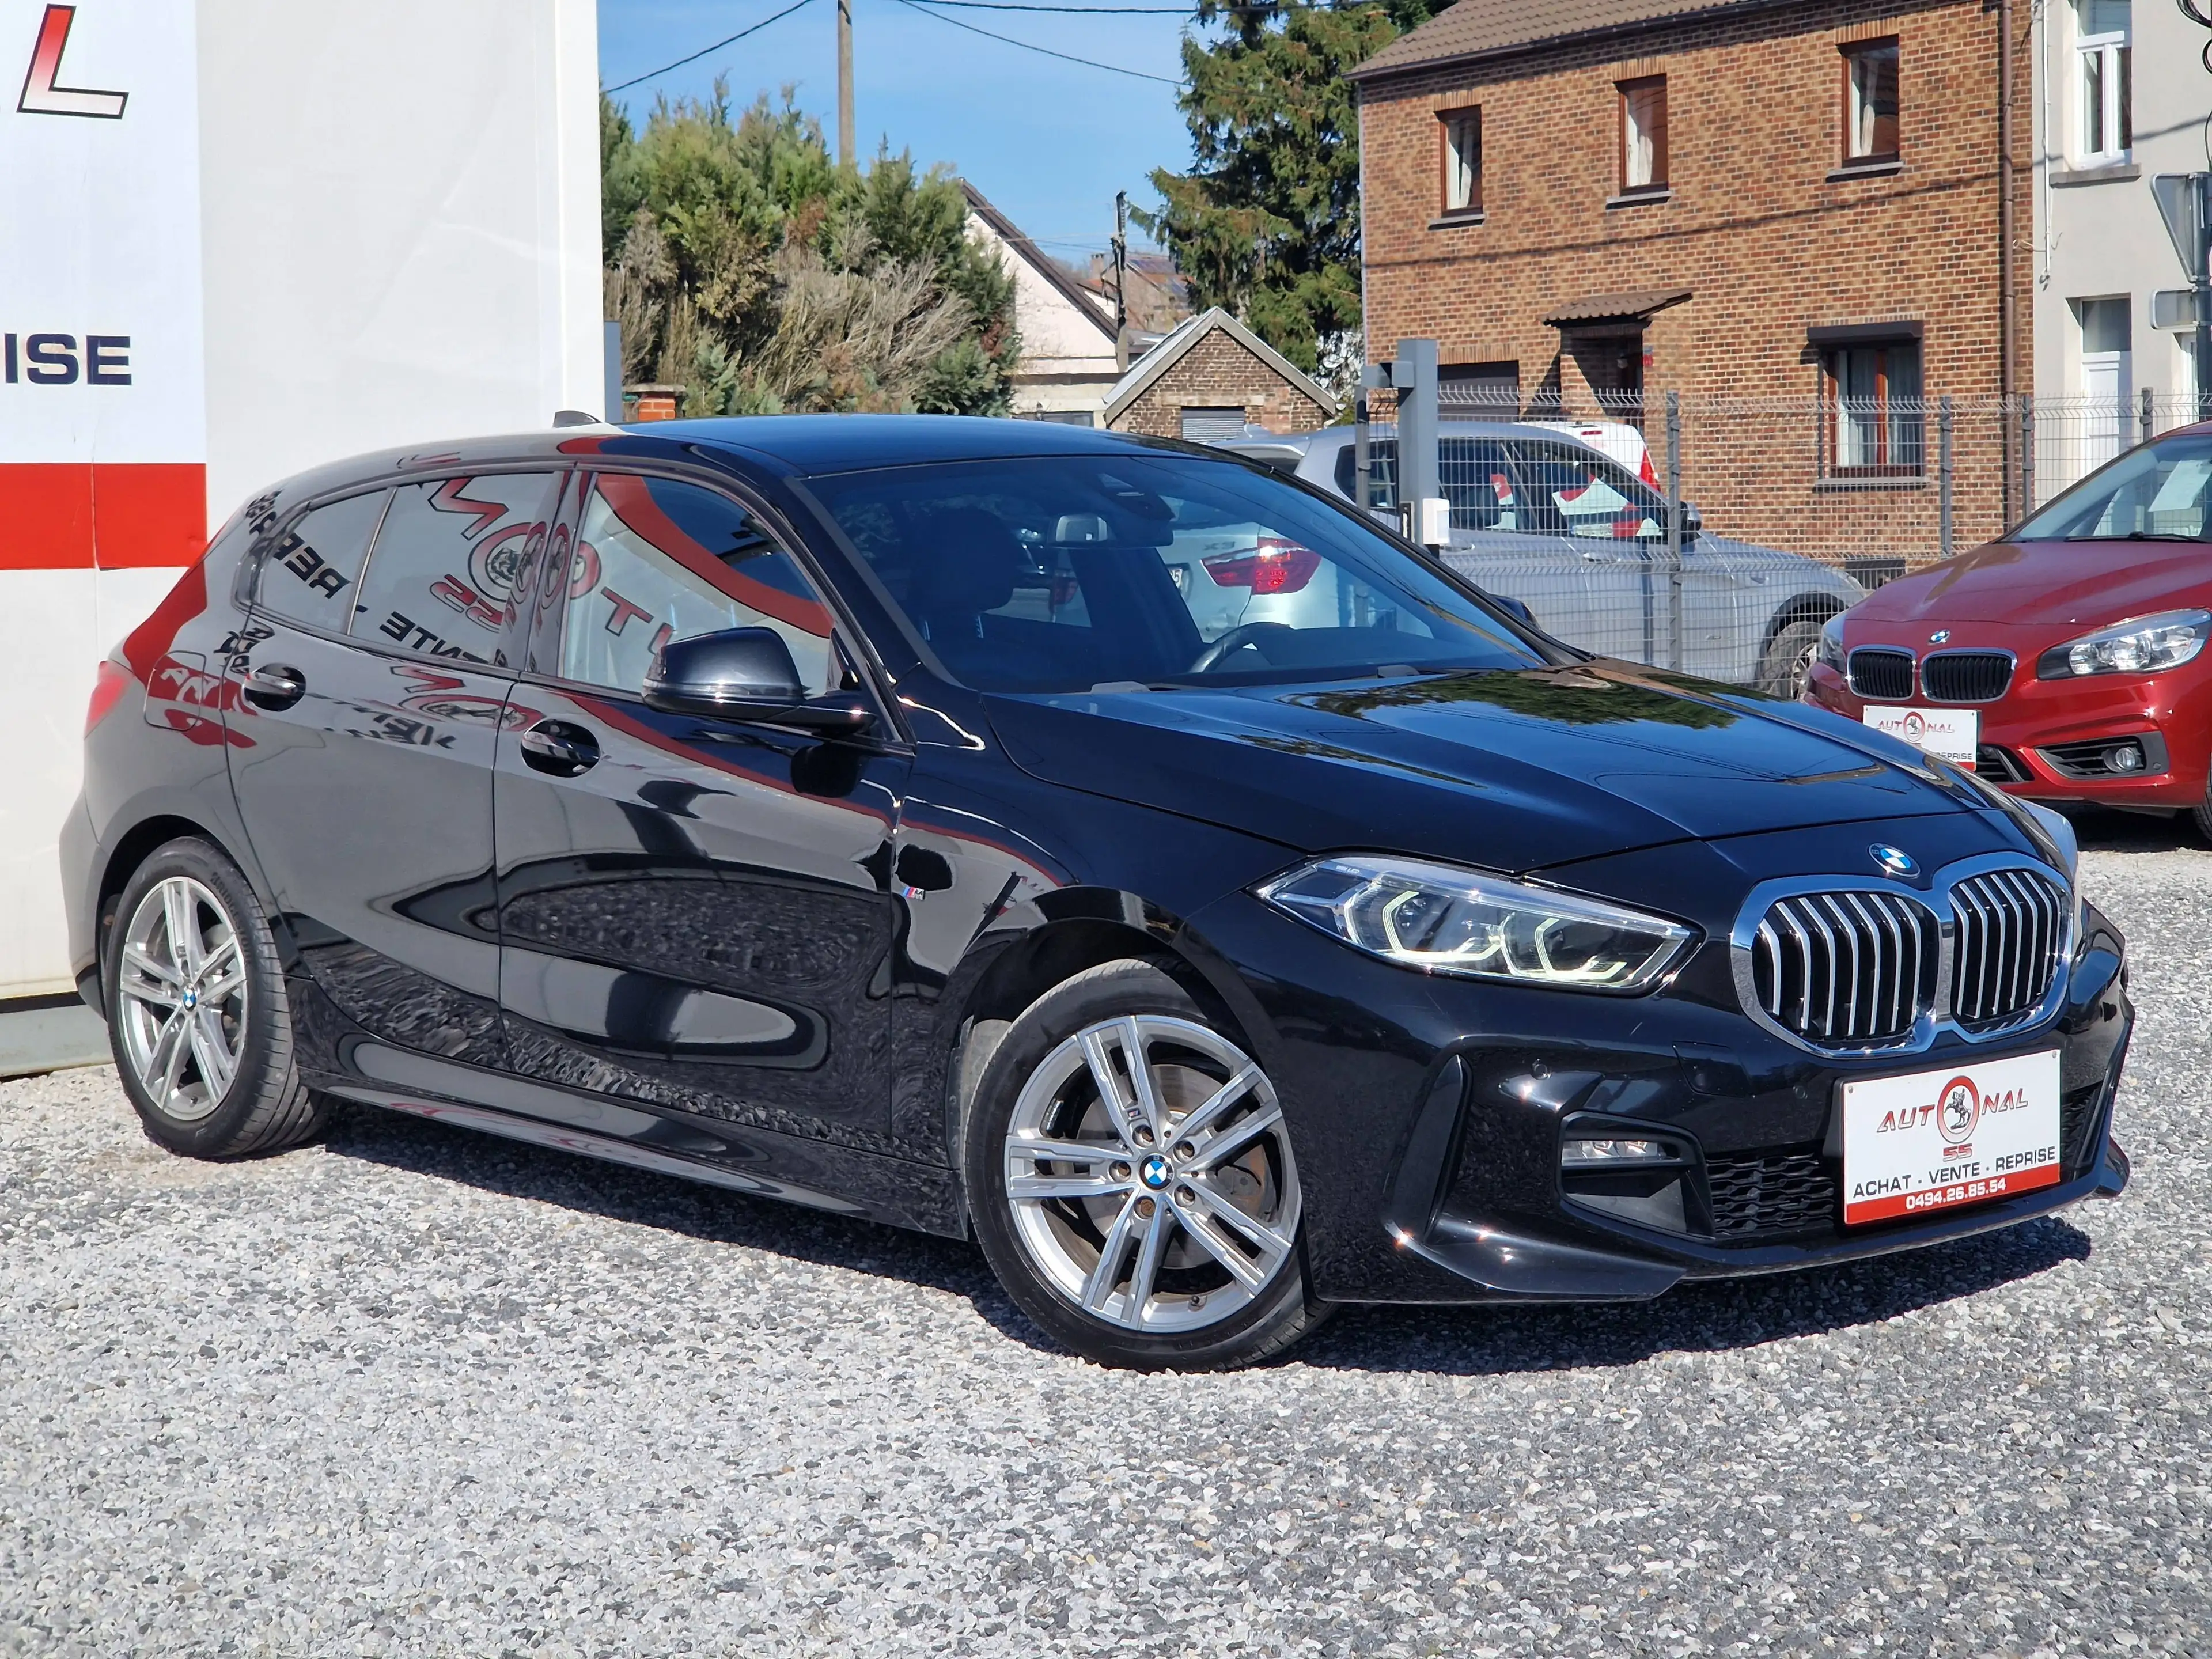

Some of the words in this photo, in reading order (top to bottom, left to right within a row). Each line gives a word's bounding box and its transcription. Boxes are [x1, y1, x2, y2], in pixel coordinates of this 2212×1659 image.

[16, 3, 129, 119] L
[5, 332, 132, 386] ISE
[1853, 1175, 1911, 1199] ACHAT
[1929, 1162, 1980, 1185] VENTE
[1996, 1146, 2055, 1172] REPRISE
[1942, 1143, 1972, 1162] 55
[1906, 1177, 2006, 1210] 0494.26.85.54
